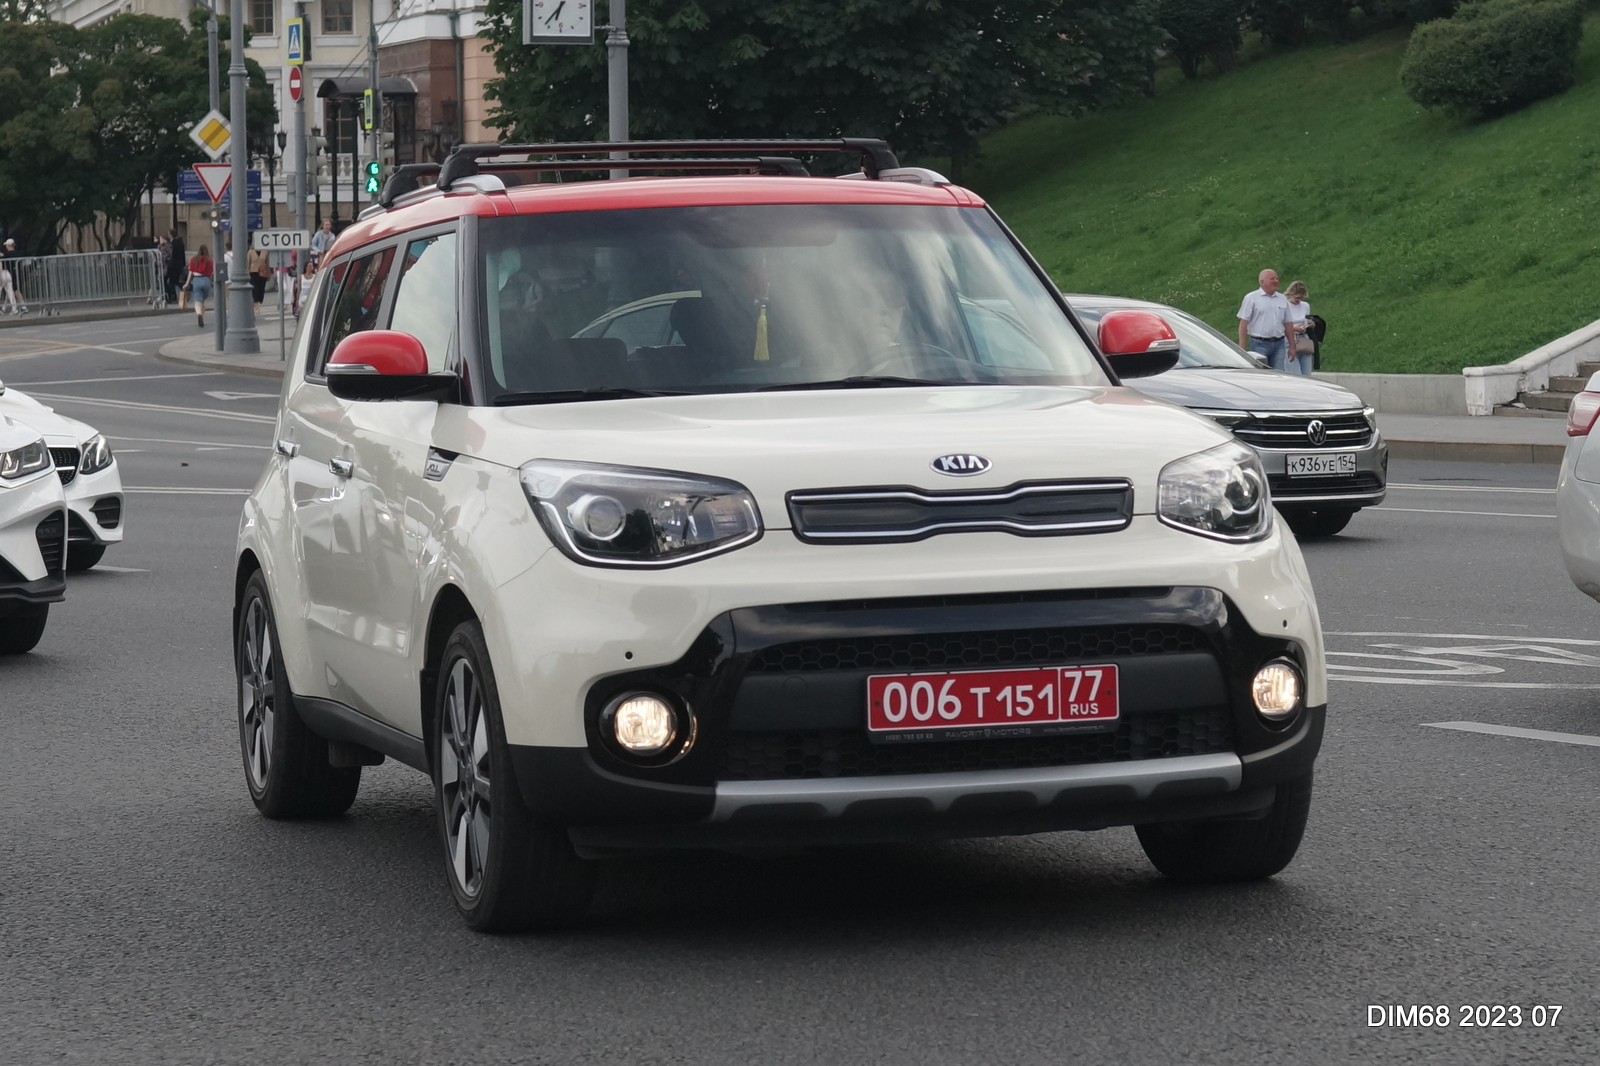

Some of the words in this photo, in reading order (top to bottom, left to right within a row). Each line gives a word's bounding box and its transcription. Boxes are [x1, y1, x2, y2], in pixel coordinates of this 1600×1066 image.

[261, 233, 302, 246] СТОП
[940, 455, 984, 470] KIA
[1064, 670, 1103, 702] 77
[1070, 703, 1099, 716] RUS
